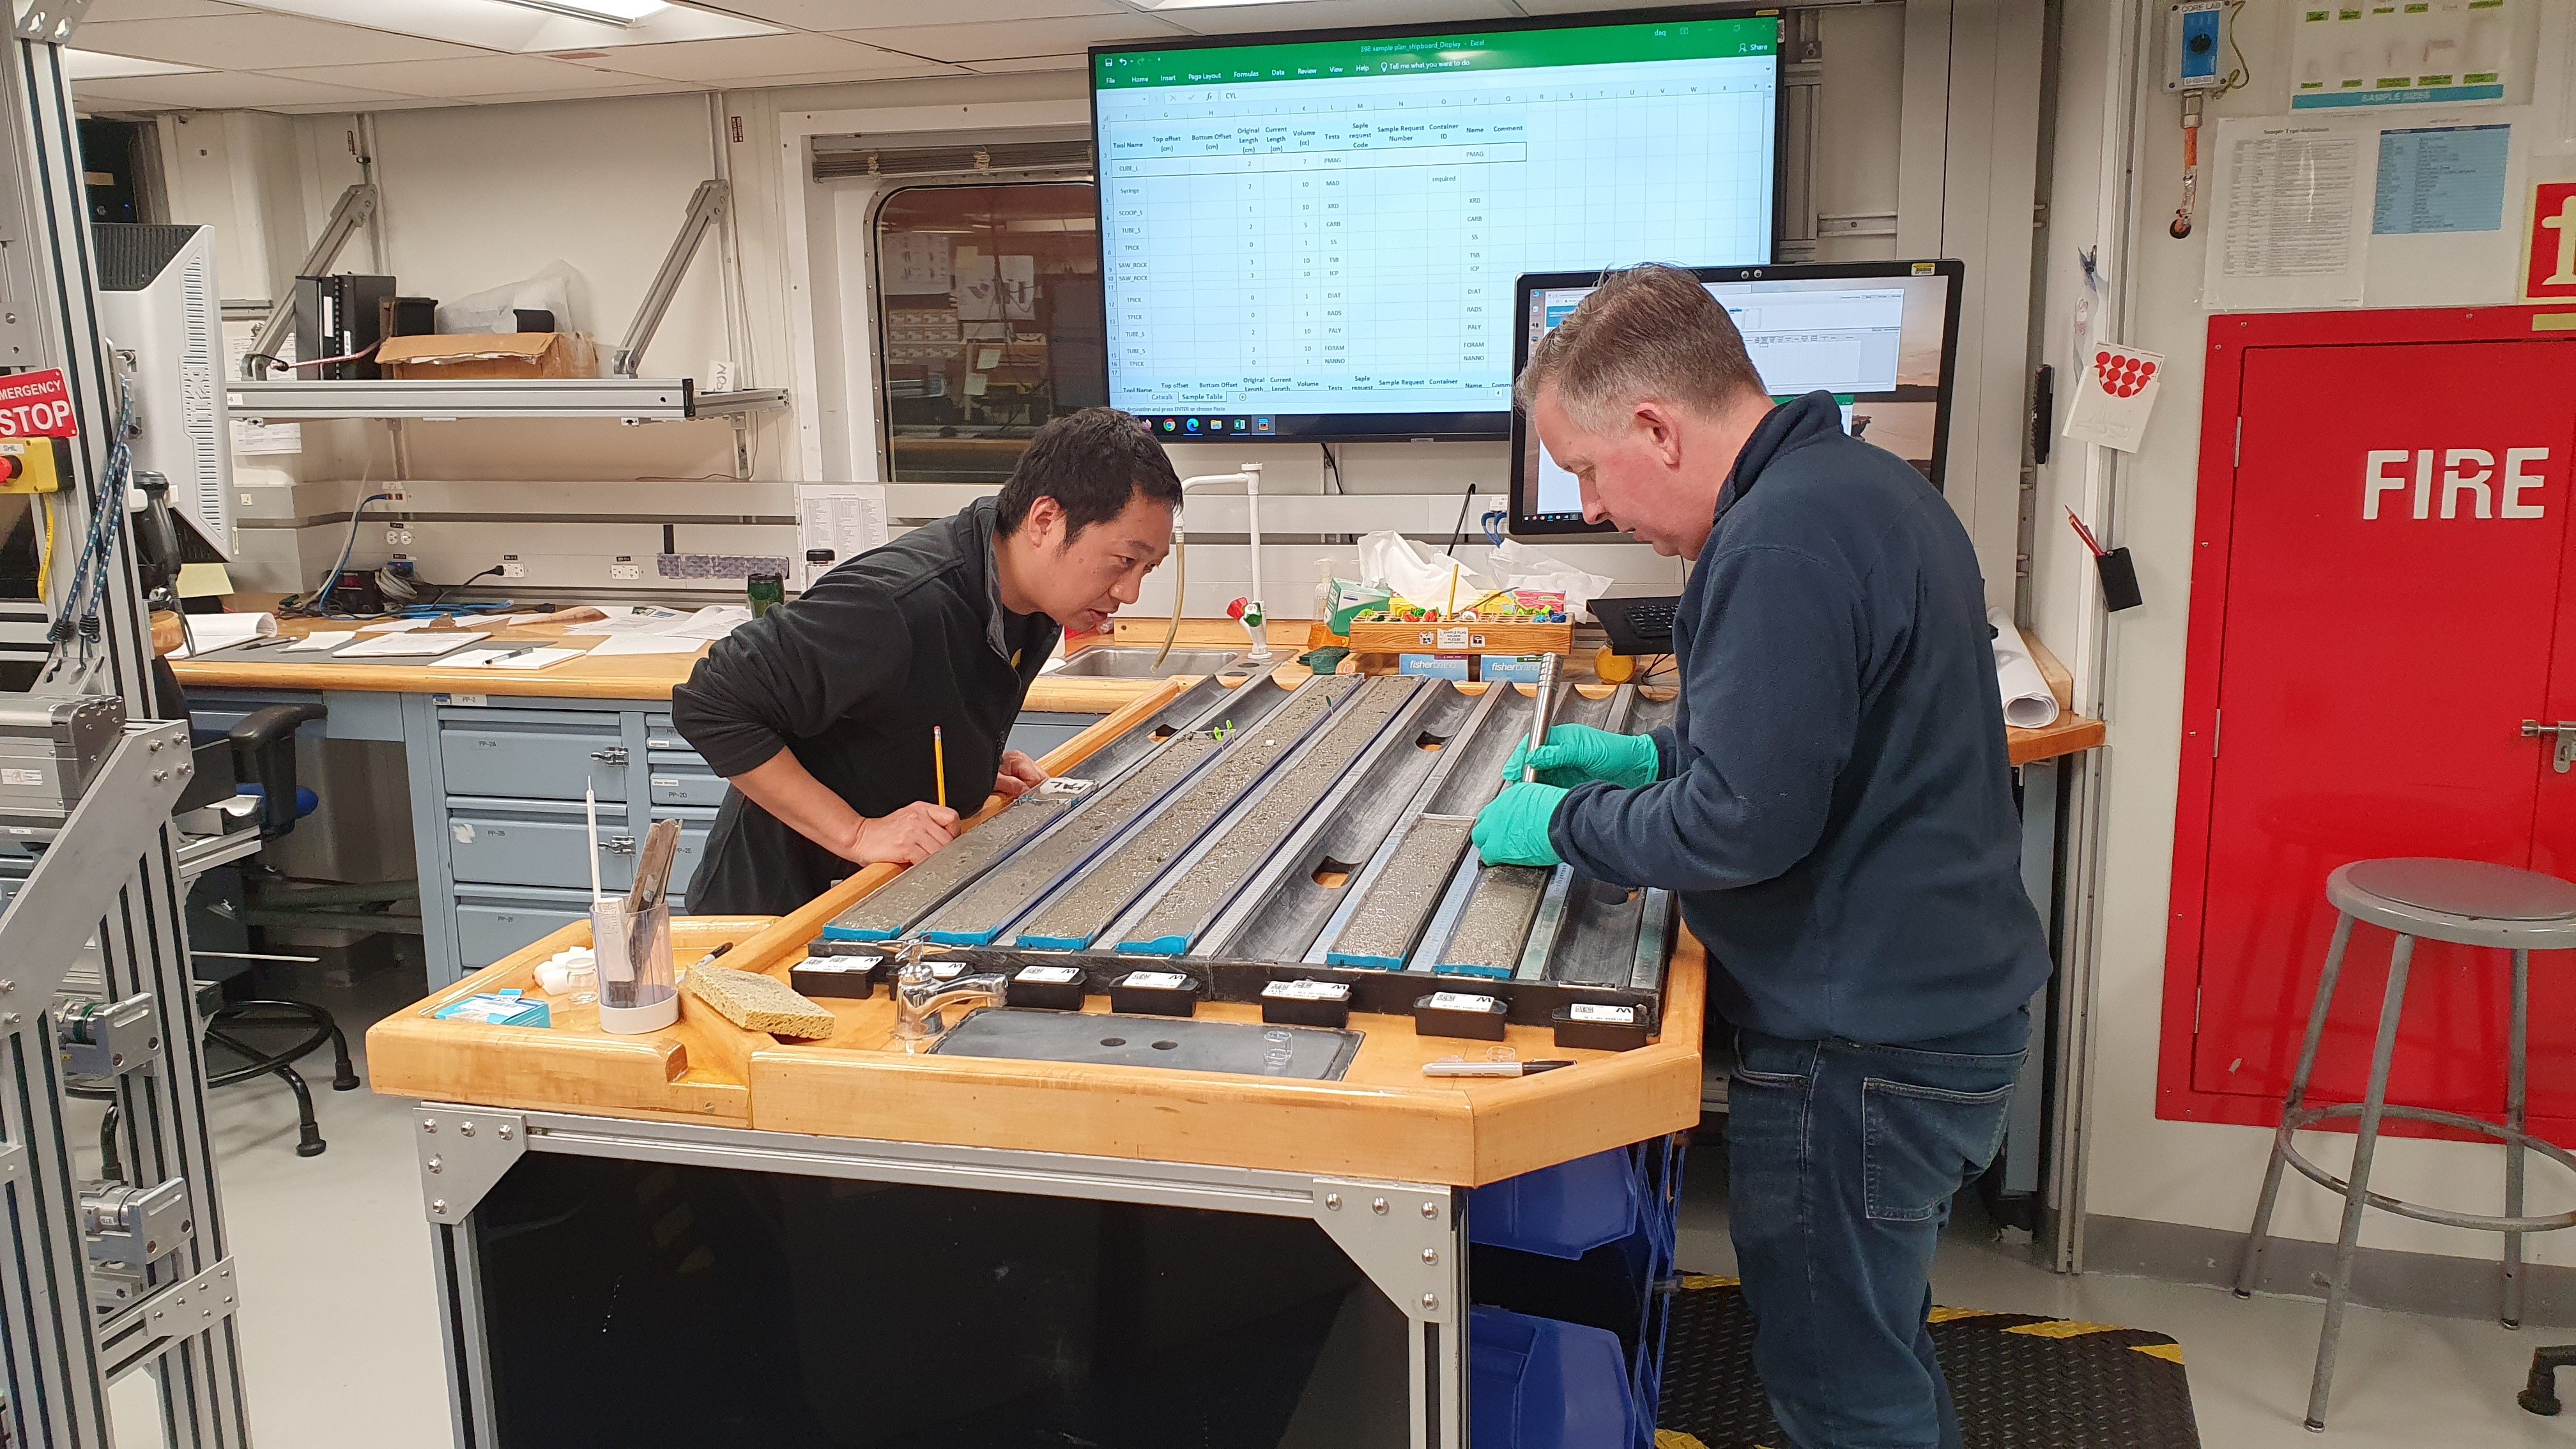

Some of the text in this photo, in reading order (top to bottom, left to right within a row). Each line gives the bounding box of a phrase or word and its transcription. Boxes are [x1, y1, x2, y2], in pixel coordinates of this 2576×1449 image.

[0, 380, 61, 401] MERGENCY
[0, 400, 70, 435] STOP
[2363, 447, 2549, 519] FIRE
